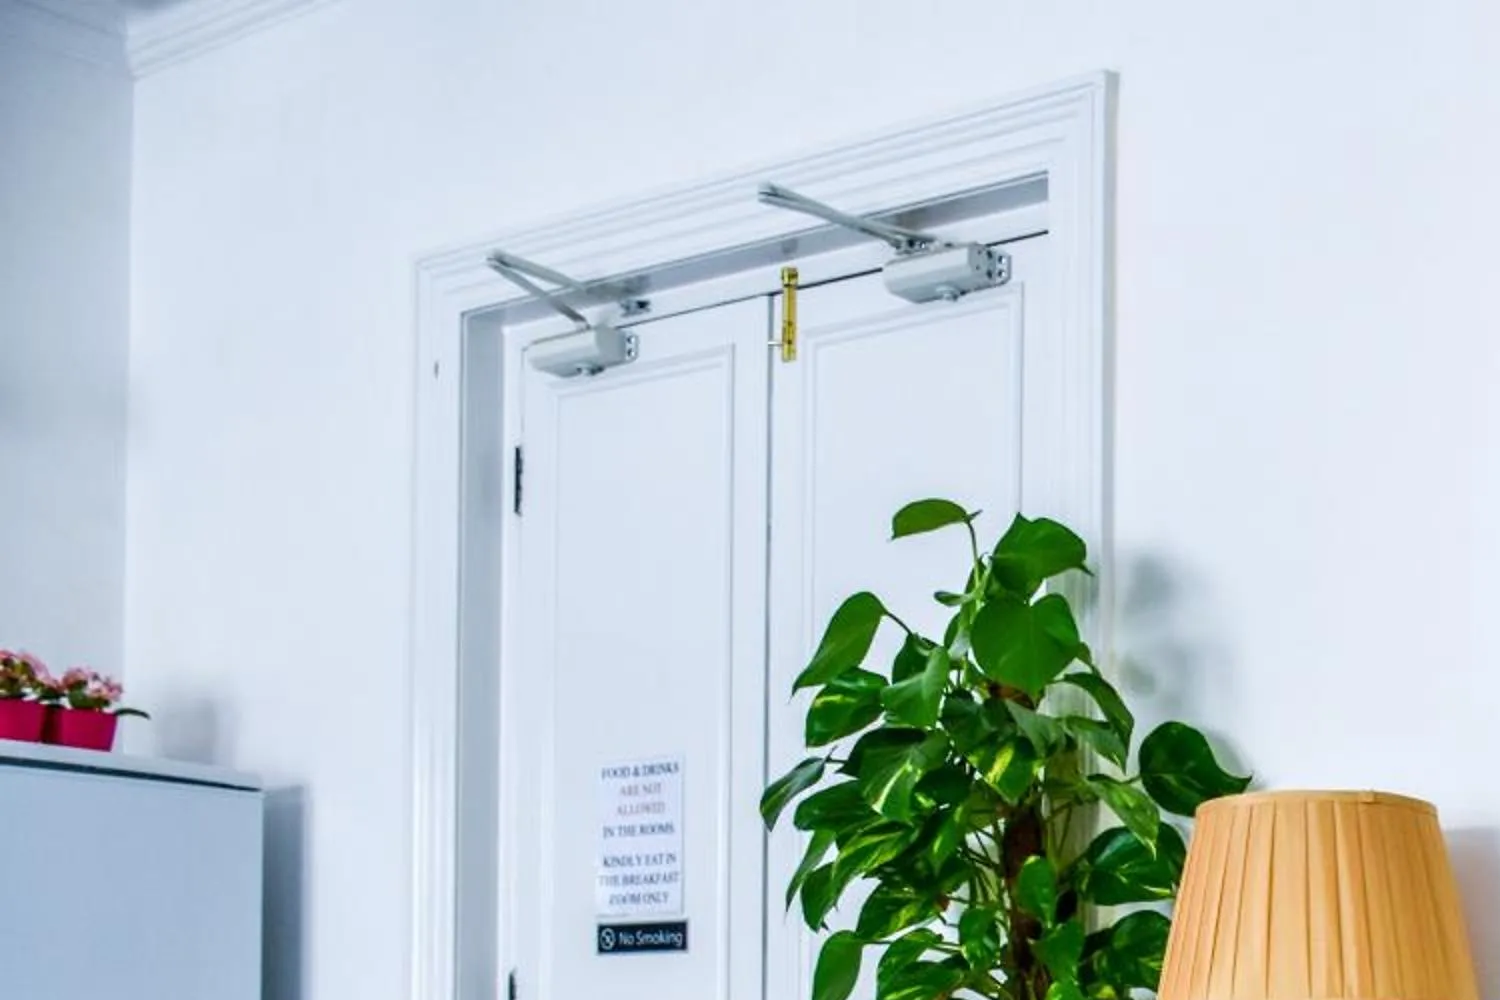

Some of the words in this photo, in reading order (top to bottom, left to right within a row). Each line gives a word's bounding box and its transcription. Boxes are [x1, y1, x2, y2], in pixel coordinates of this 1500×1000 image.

[601, 766, 631, 780] FOOD
[642, 761, 679, 776] DRINKS
[603, 826, 615, 839] IN
[618, 825, 636, 838] THE
[639, 821, 675, 836] ROOMS
[603, 853, 641, 868] KINDLY
[644, 852, 664, 866] EAT
[665, 852, 677, 865] IN
[622, 870, 680, 886] BREAKFAST
[619, 931, 635, 945] No
[636, 929, 684, 948] Smoking
